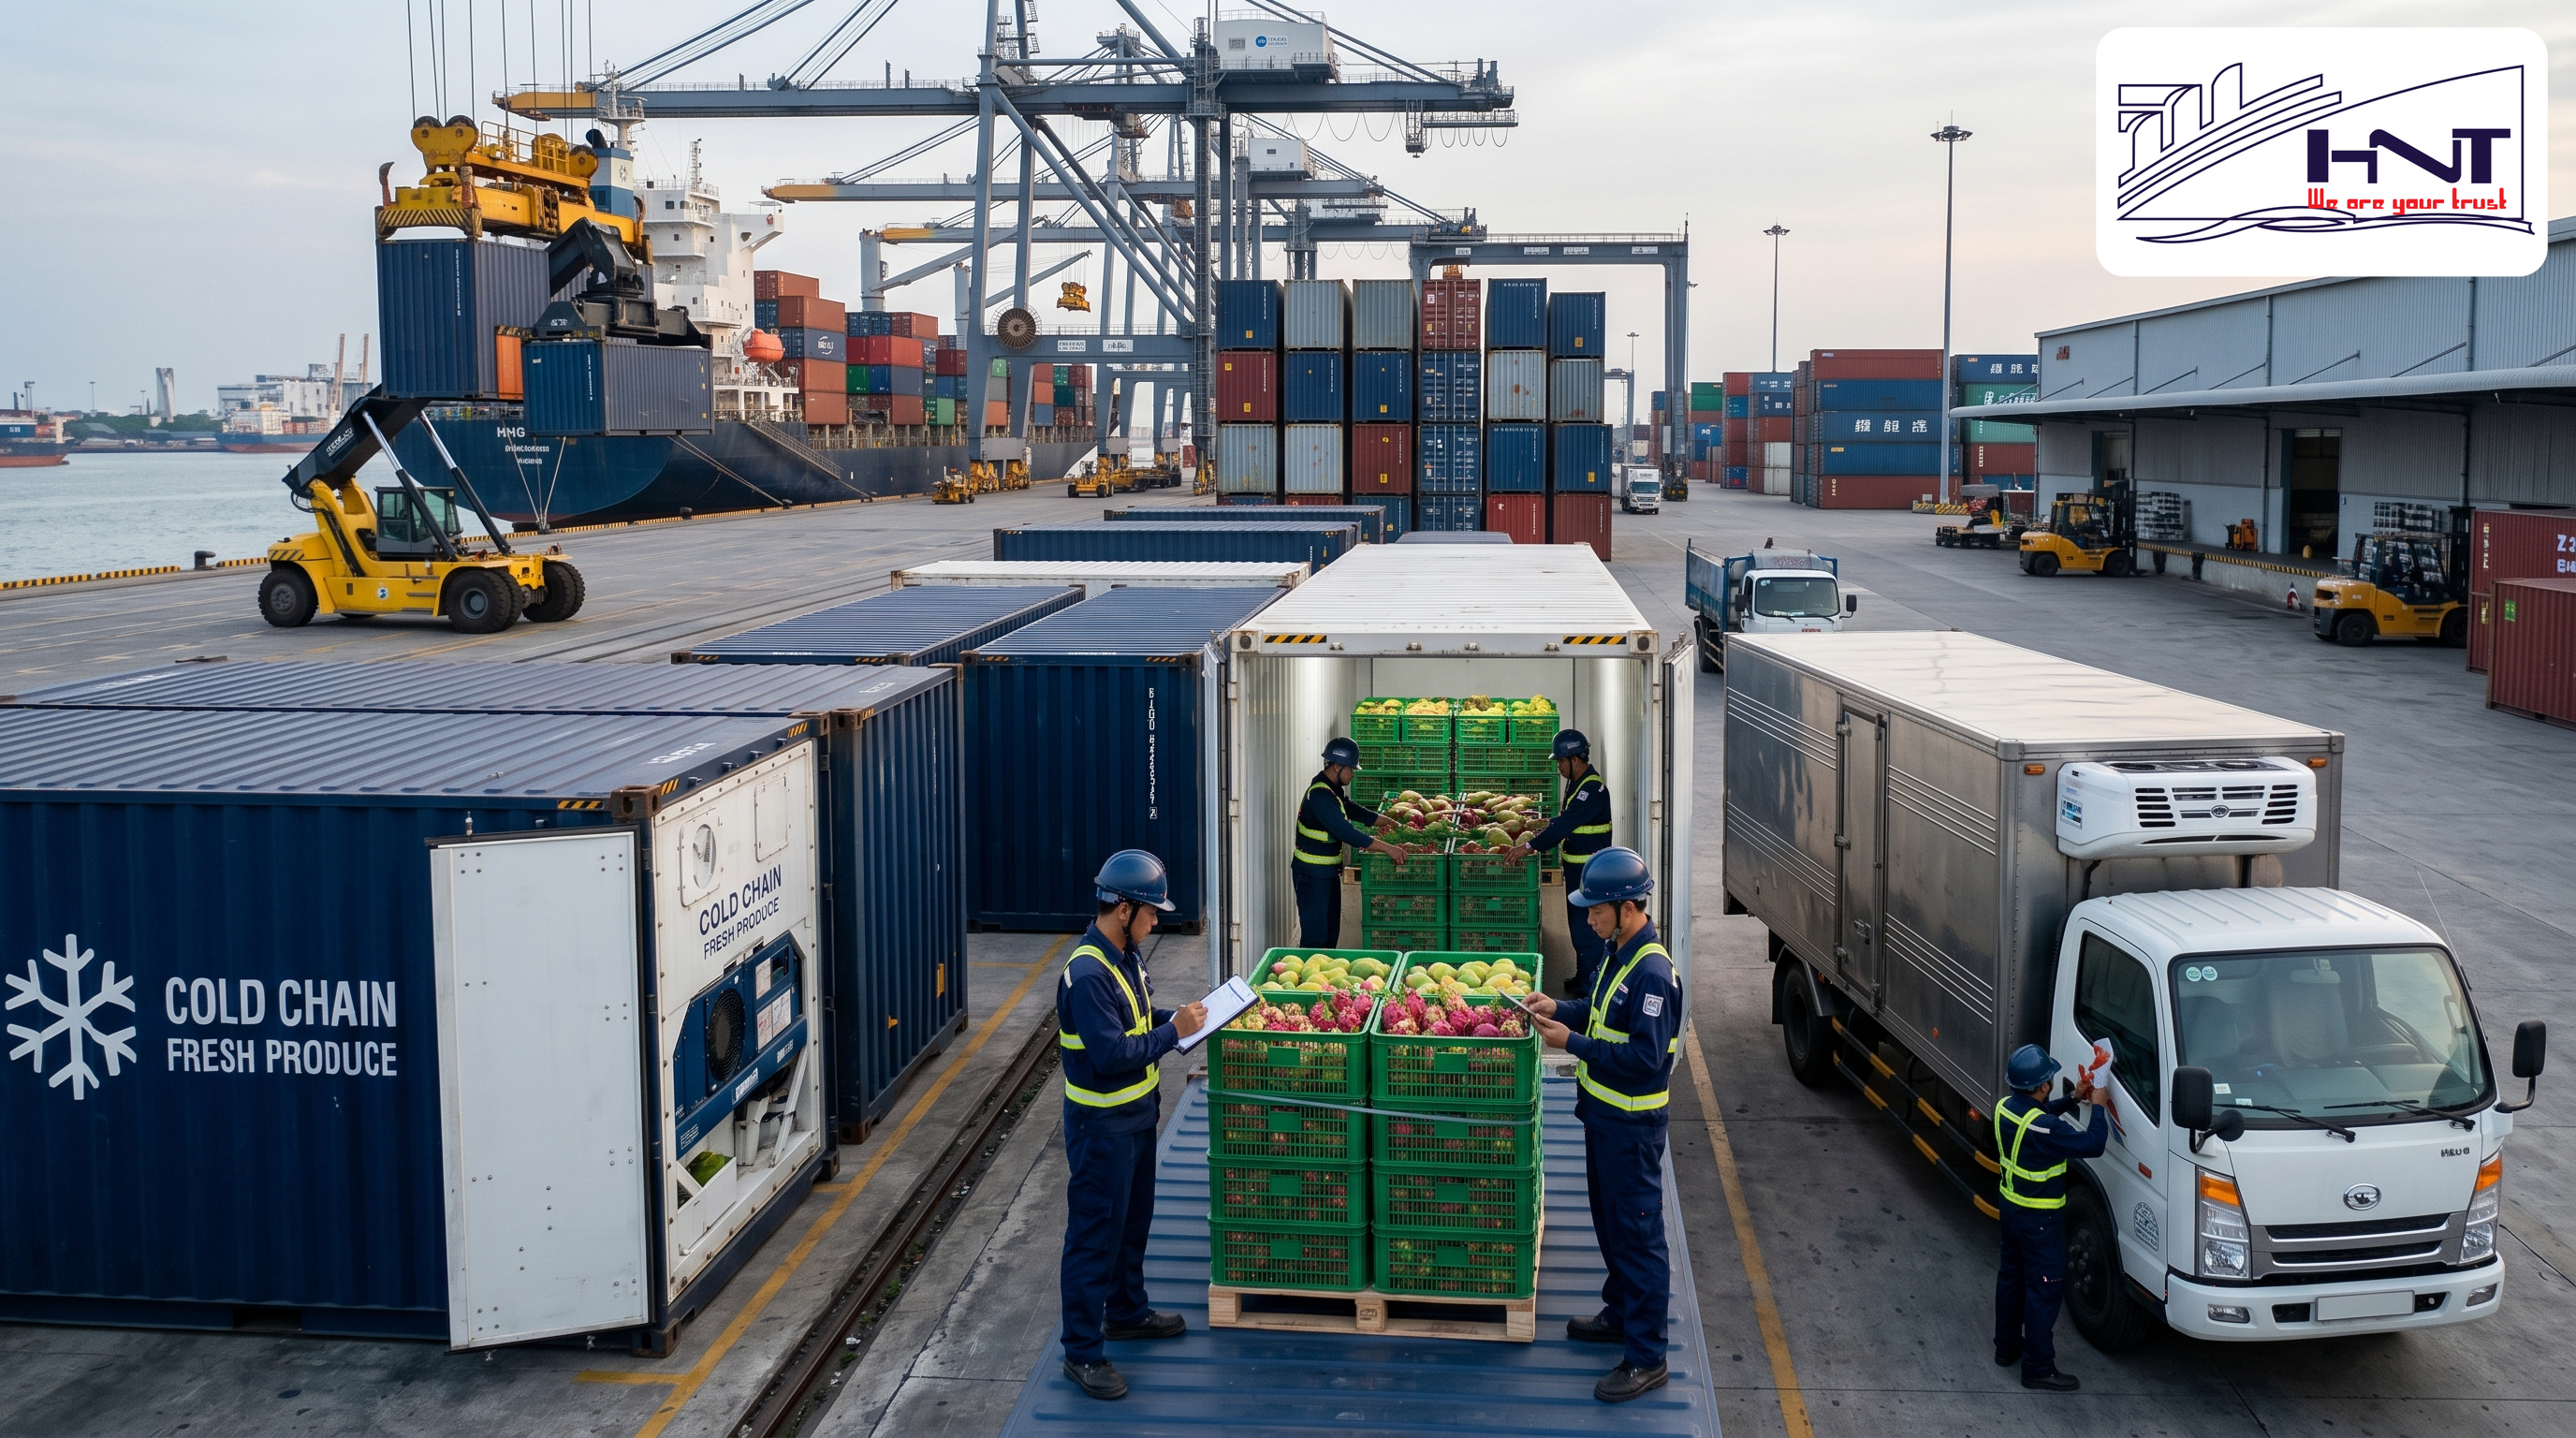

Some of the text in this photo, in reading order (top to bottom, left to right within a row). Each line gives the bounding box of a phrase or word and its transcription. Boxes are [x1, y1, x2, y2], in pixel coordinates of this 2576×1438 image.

[699, 864, 782, 936] COLD CHAIN
[703, 896, 779, 961] FRESH PRODUCE
[165, 976, 397, 1028] COLD CHAIN
[167, 1037, 398, 1077] FRESH PRODUCE
